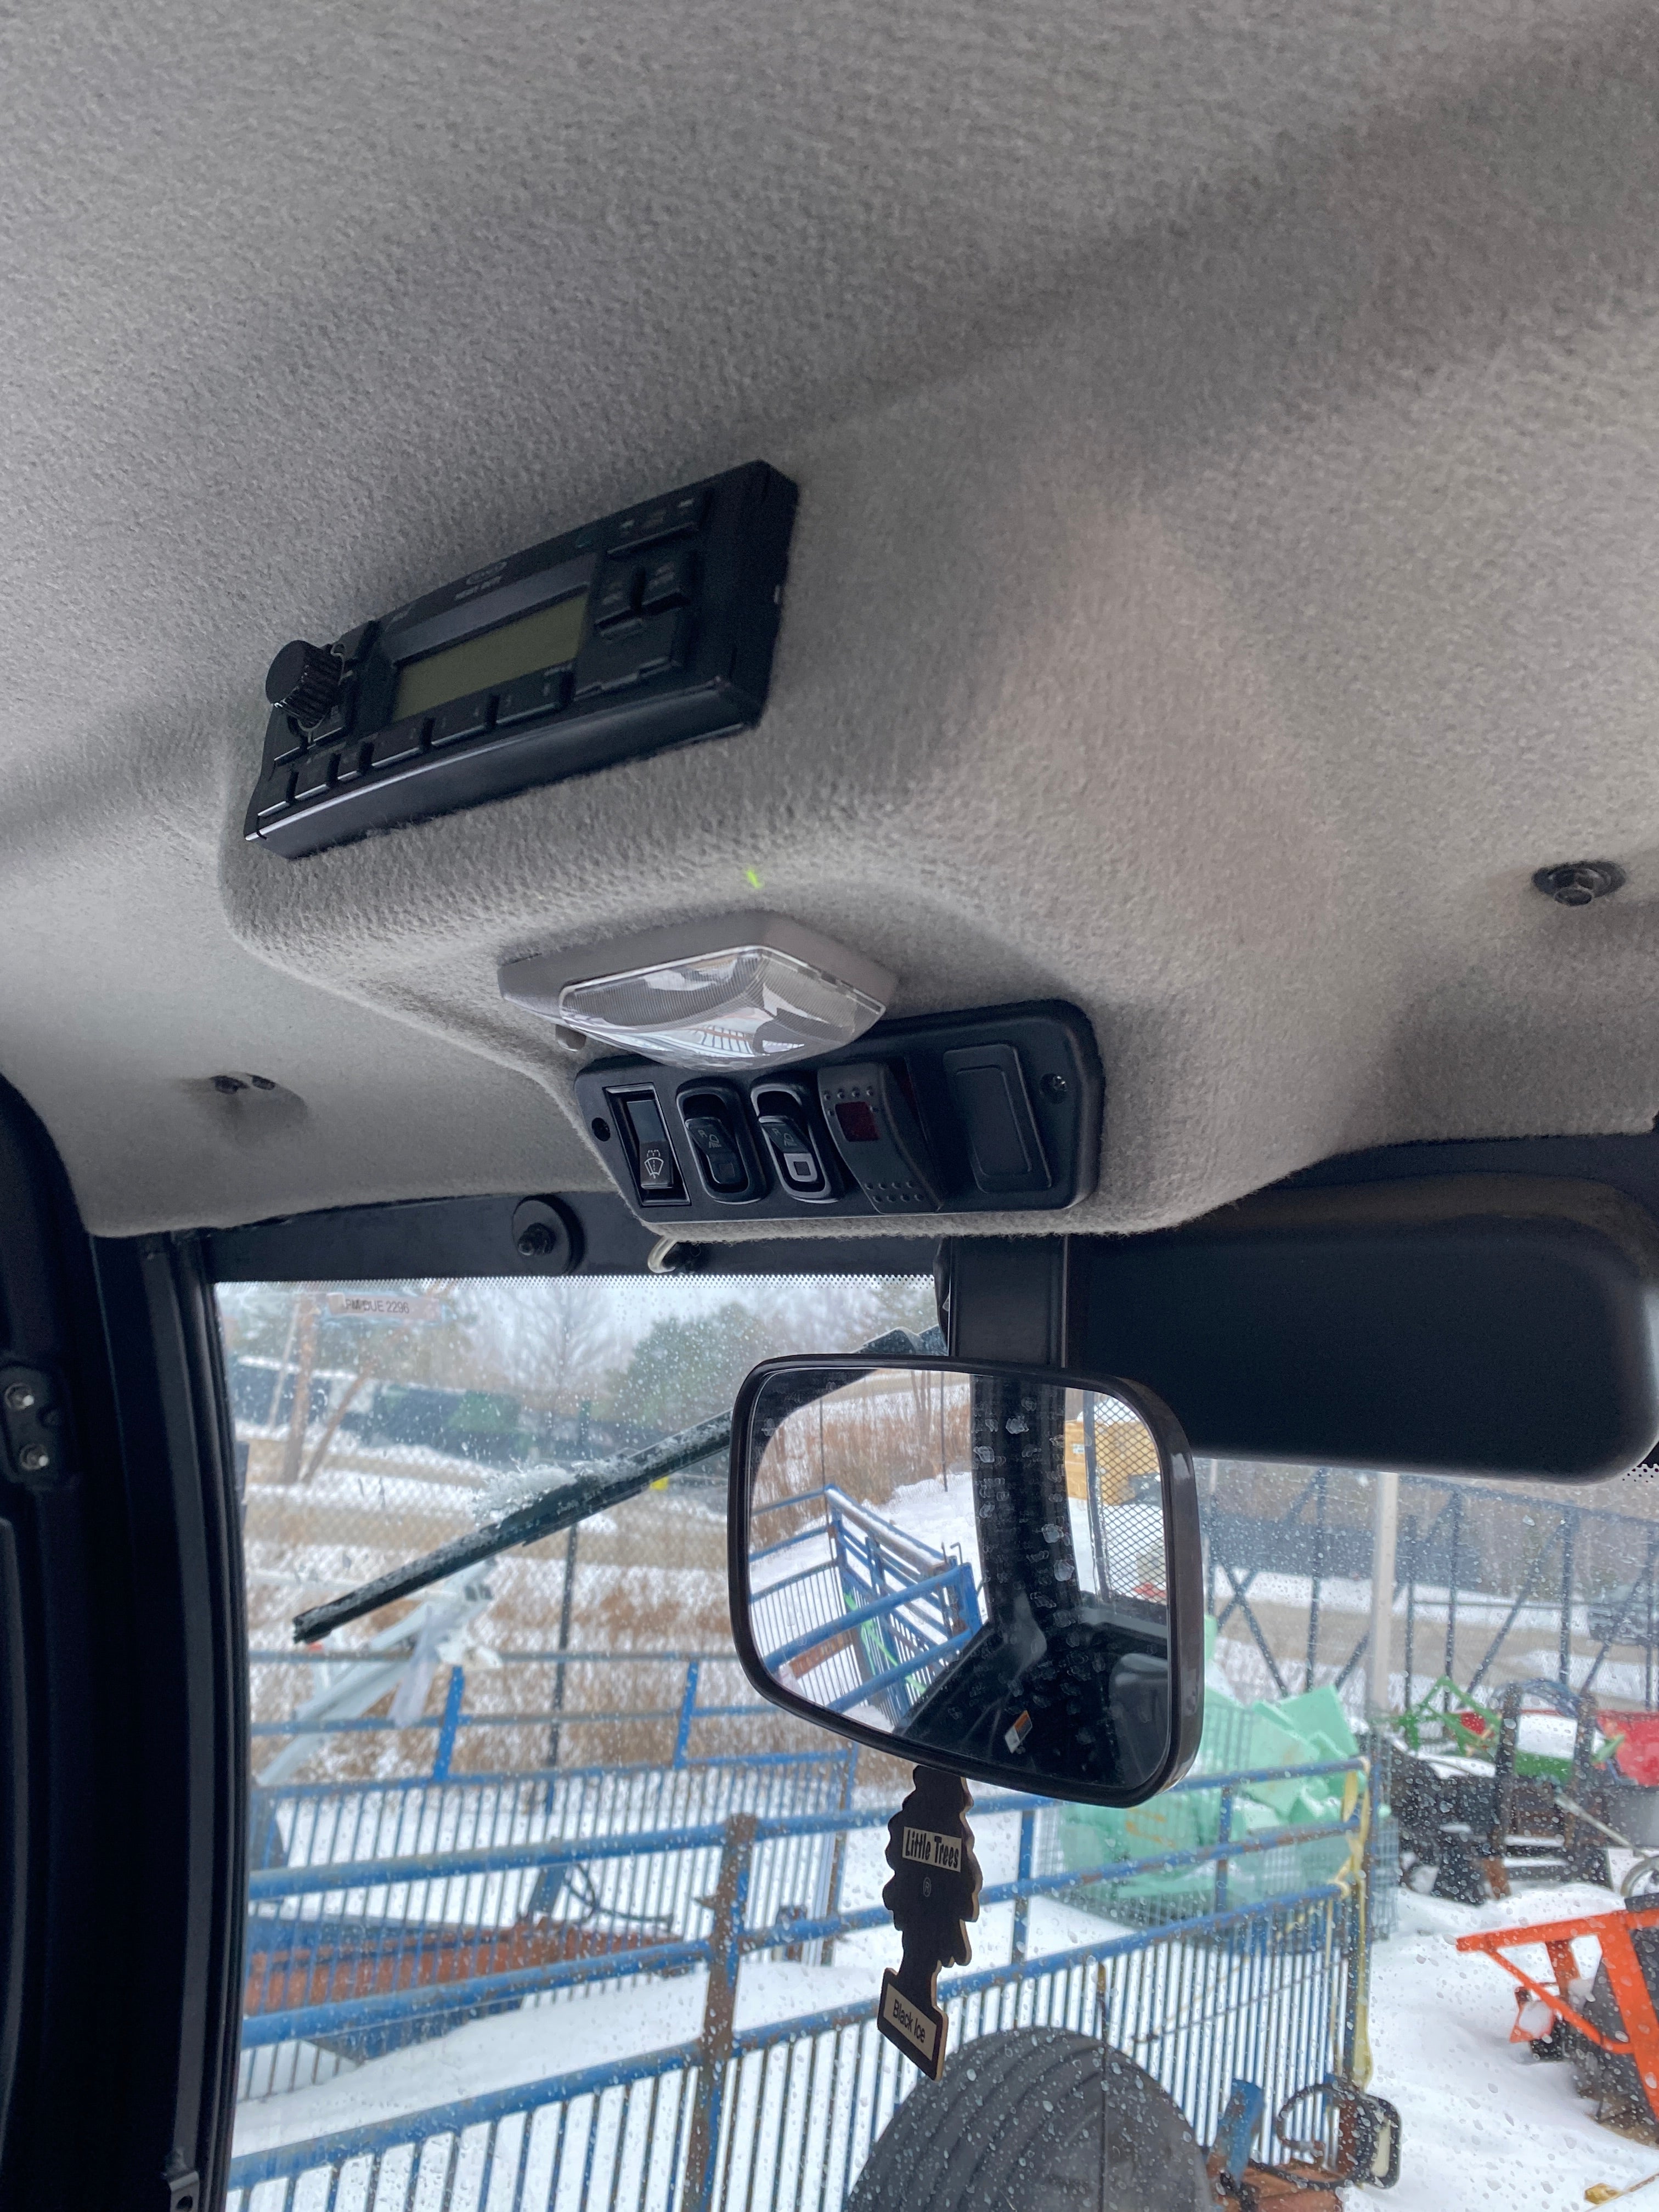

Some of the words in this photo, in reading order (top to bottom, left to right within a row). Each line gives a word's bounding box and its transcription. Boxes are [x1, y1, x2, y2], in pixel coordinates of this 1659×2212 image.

[363, 1300, 384, 1312] DUE
[386, 1301, 410, 1314] 2296
[905, 1830, 931, 1860] Little
[934, 1836, 959, 1869] Trees
[893, 1999, 913, 2033] Black
[914, 2018, 926, 2043] Ice
